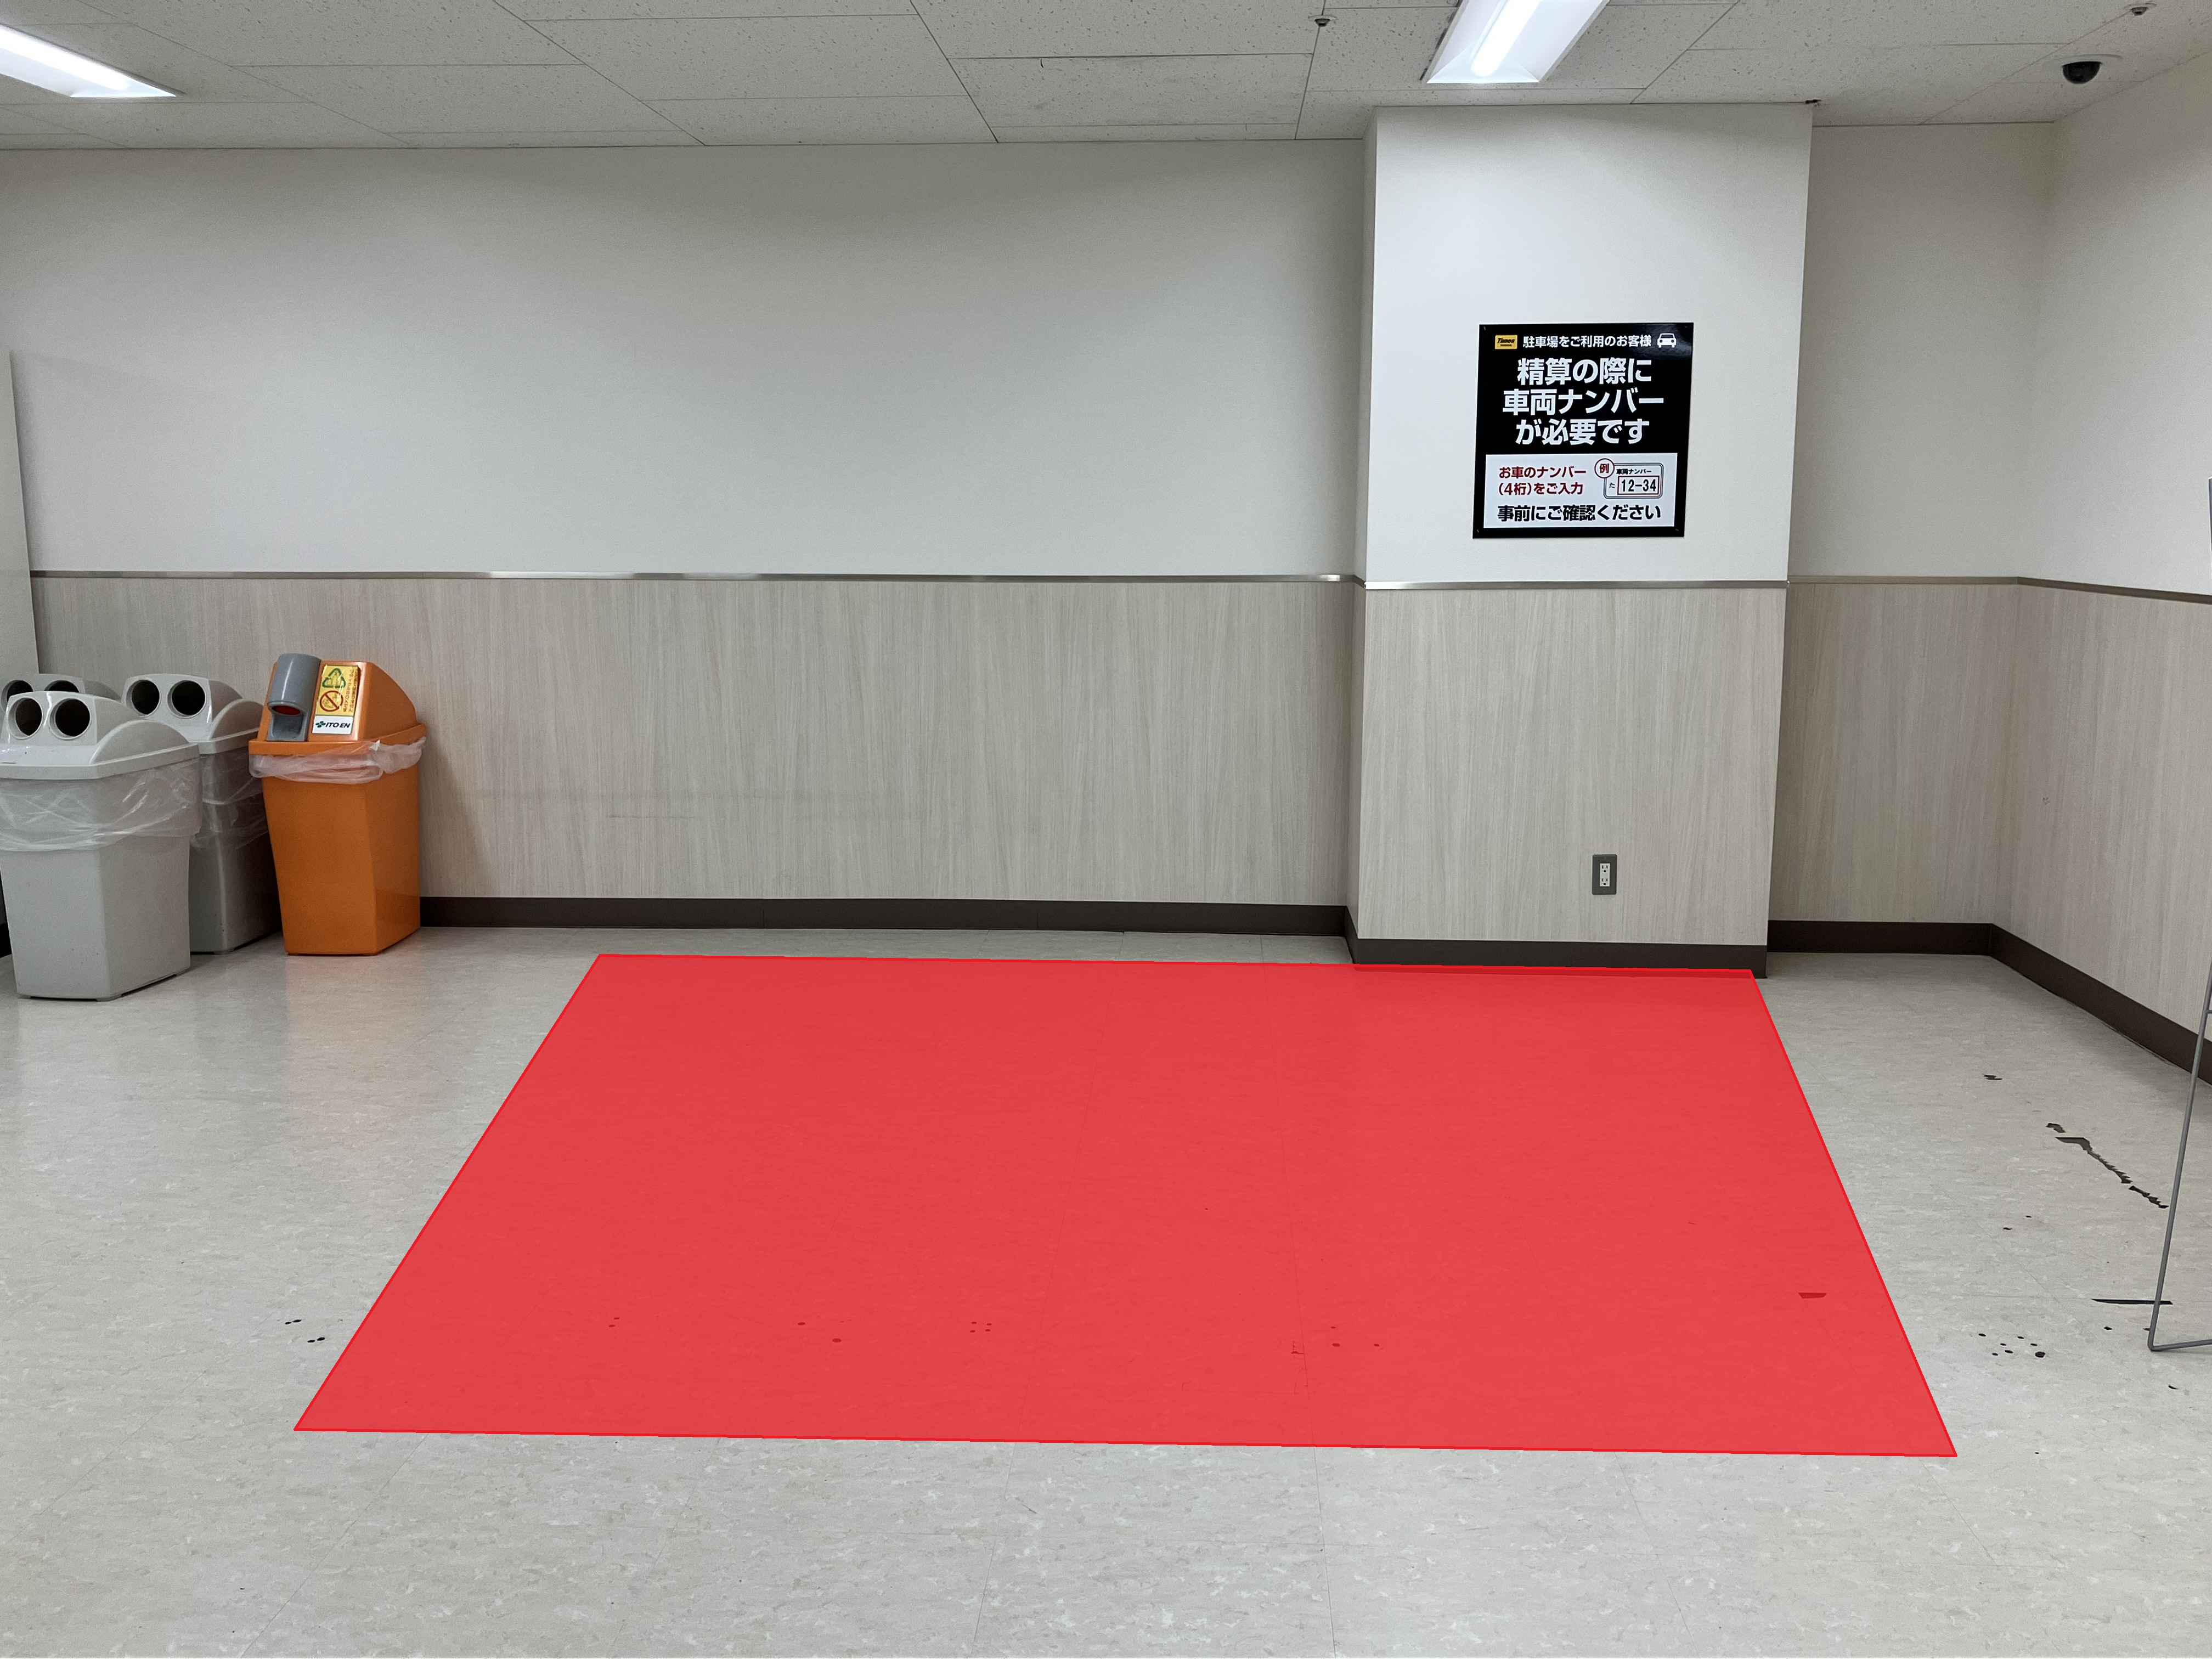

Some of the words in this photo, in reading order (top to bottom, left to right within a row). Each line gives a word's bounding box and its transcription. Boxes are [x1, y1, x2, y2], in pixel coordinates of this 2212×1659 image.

[1522, 335, 1652, 348] 駐車場をご利用のお客様
[1517, 357, 1652, 386] 精算の際に
[1502, 387, 1664, 416] 車両ナンバー
[1515, 419, 1650, 445] が必要です
[1499, 466, 1587, 479] お車のナンバー
[1599, 463, 1610, 473] 例
[1498, 482, 1583, 495] (4桁)をご入力
[1621, 478, 1657, 492] 12-34
[1497, 504, 1661, 522] 事前にご確認ください
